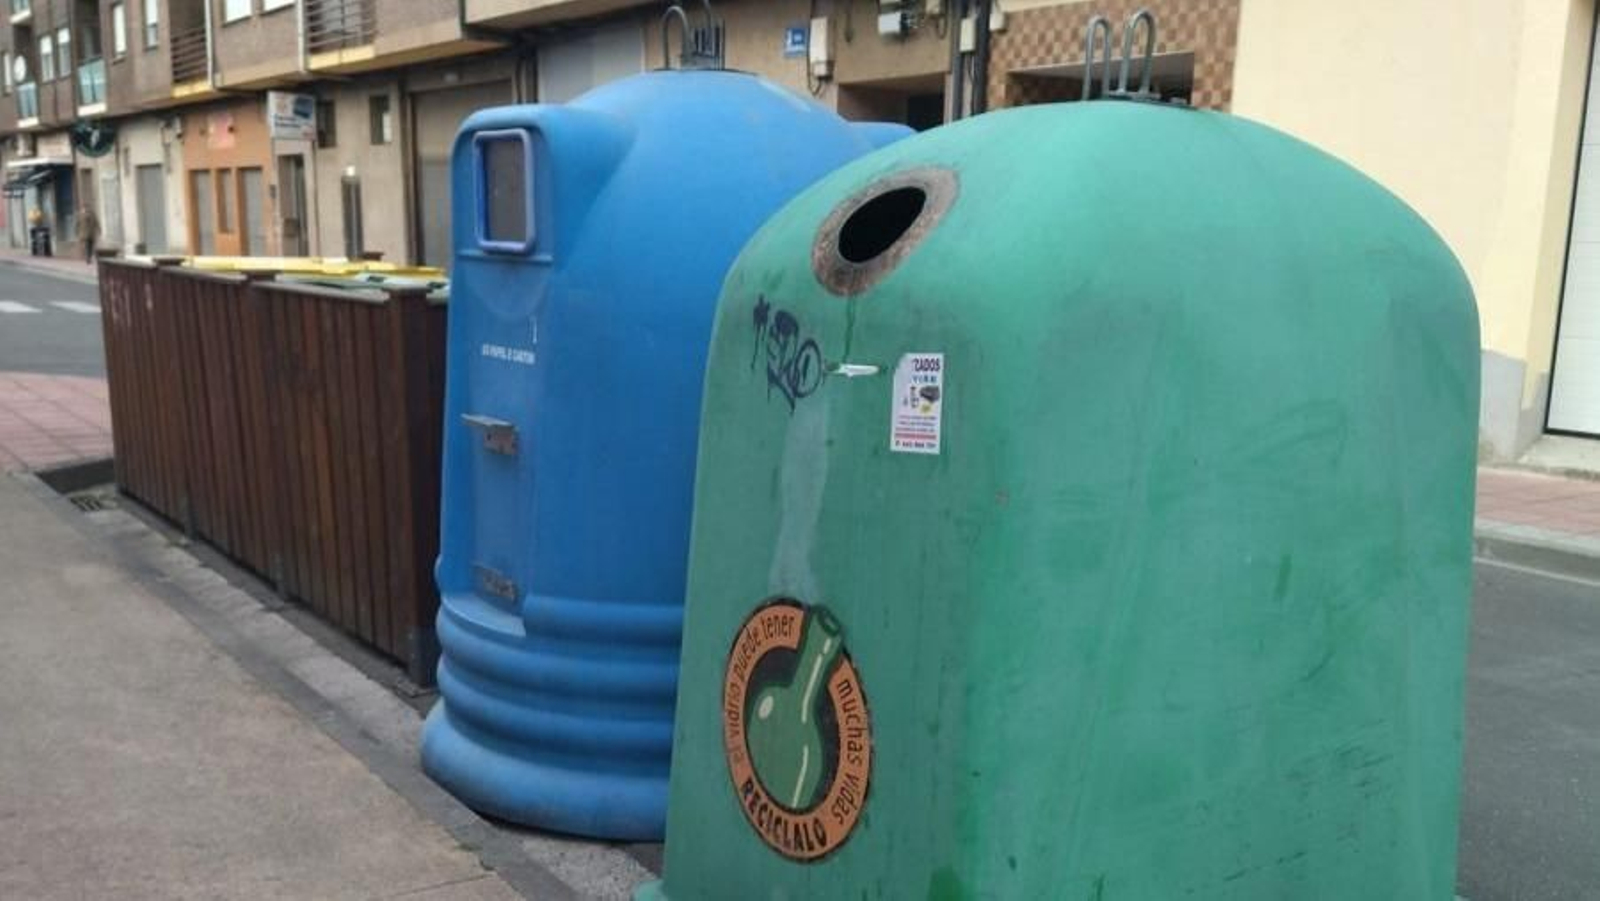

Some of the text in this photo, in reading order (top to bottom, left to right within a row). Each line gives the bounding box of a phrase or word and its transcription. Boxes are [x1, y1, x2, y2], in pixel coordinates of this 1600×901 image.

[733, 624, 761, 683] puede
[760, 614, 795, 640] tener
[831, 679, 868, 825] muchas vidas
[741, 775, 828, 852] RECICLALO
